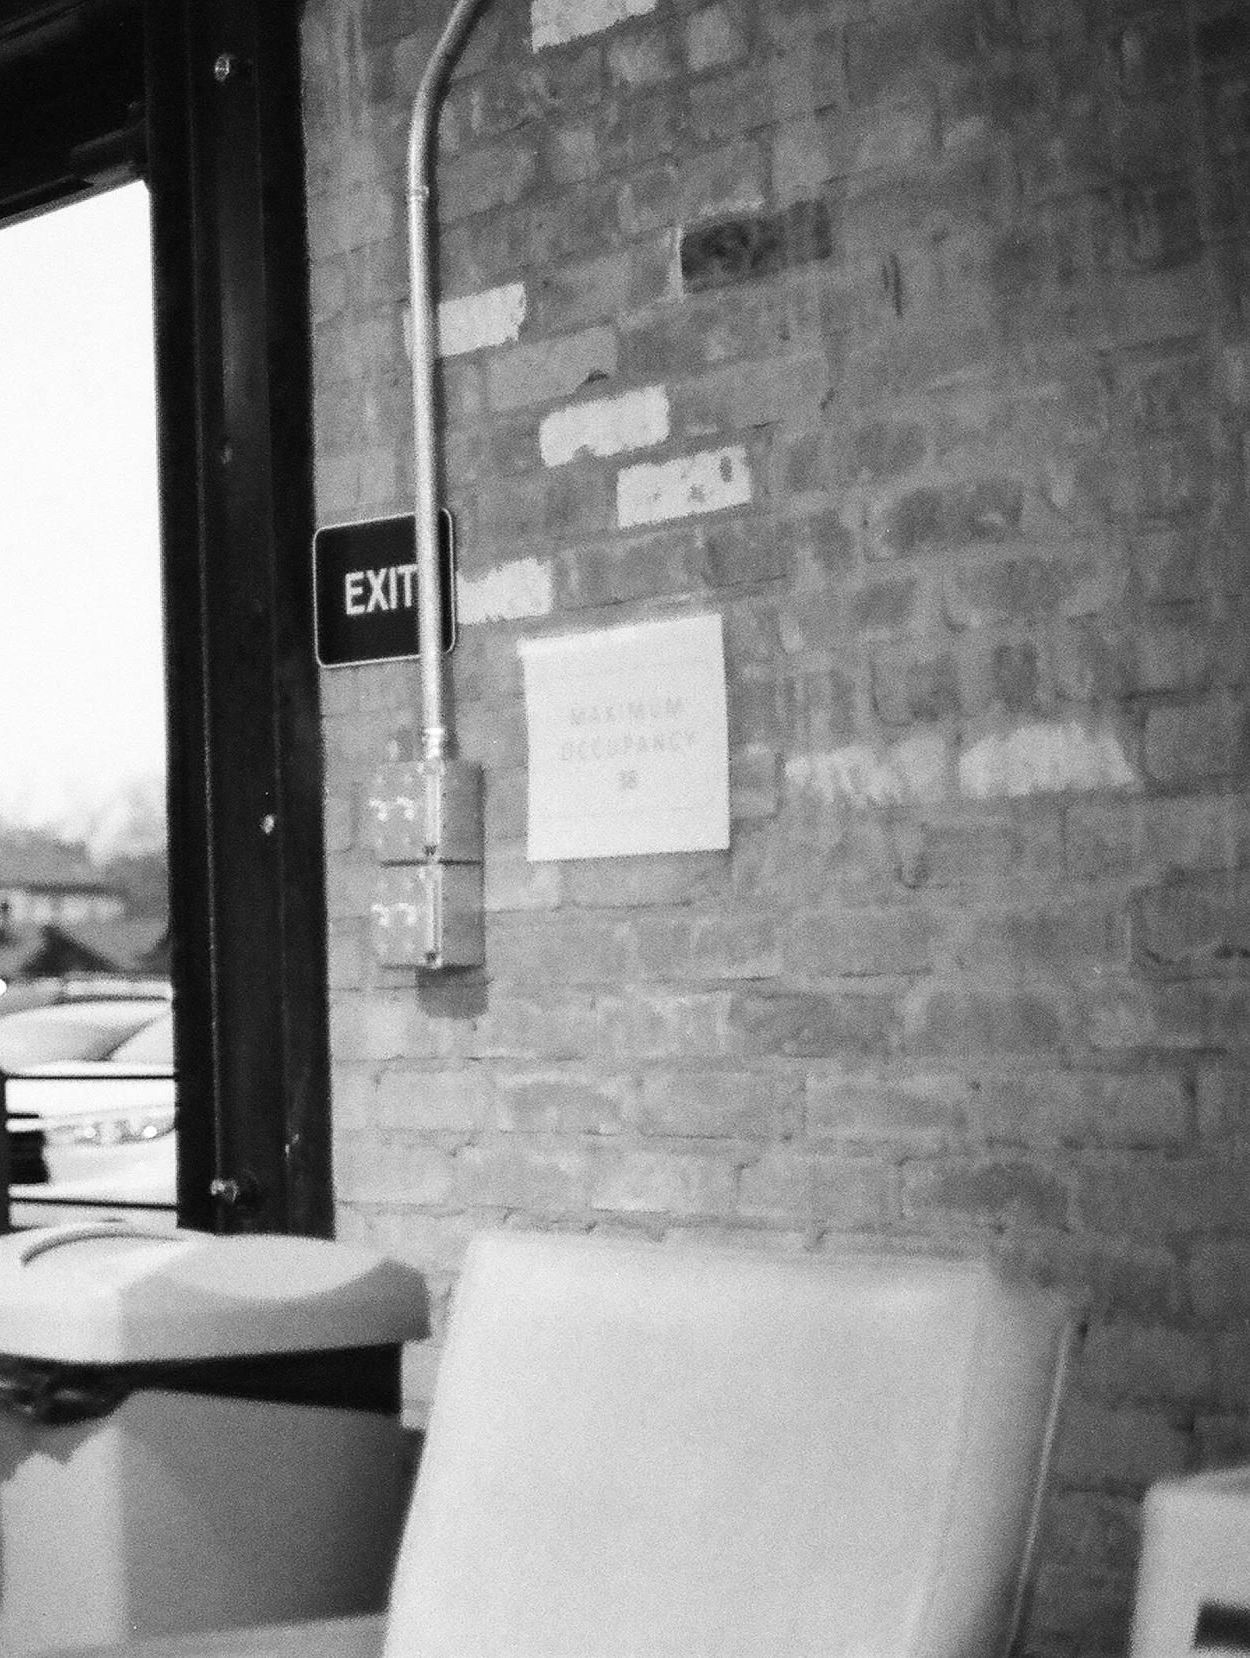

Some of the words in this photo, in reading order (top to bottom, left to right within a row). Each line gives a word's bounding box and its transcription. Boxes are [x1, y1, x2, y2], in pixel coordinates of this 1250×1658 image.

[345, 563, 418, 615] EXIT
[569, 695, 687, 726] MAXIMUM
[559, 728, 698, 762] OCCUPANCY
